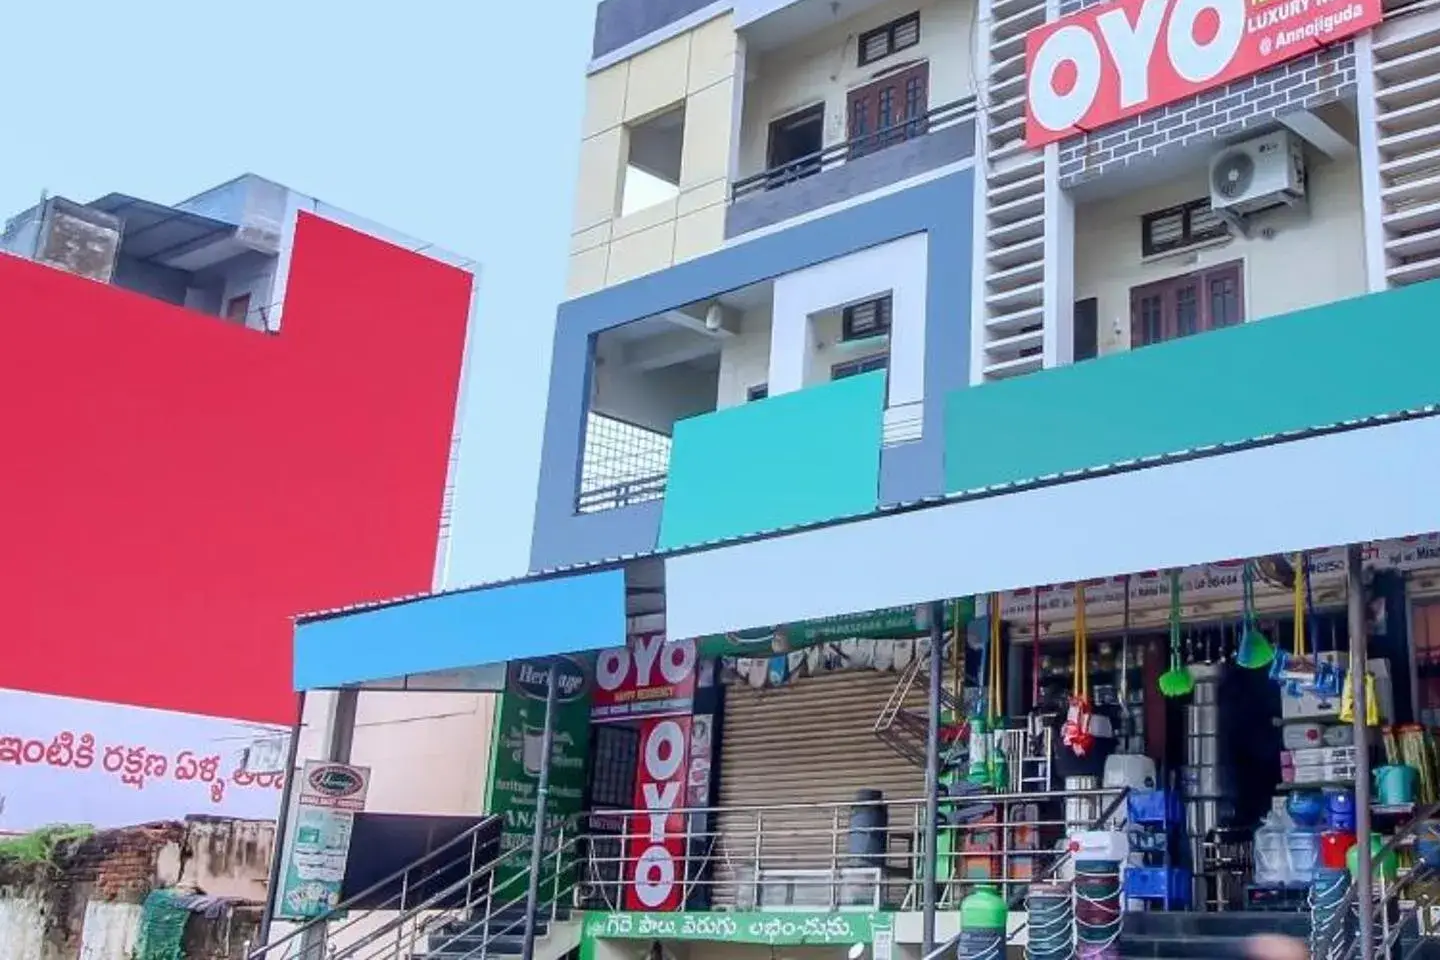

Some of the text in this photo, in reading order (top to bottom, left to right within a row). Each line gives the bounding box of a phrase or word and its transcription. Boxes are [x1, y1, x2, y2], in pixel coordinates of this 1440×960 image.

[1275, 4, 1364, 50] Annojiguda
[519, 663, 583, 695] Herage
[596, 634, 697, 690] OYO
[103, 744, 168, 791] రక్షణ
[634, 721, 685, 908] OYO
